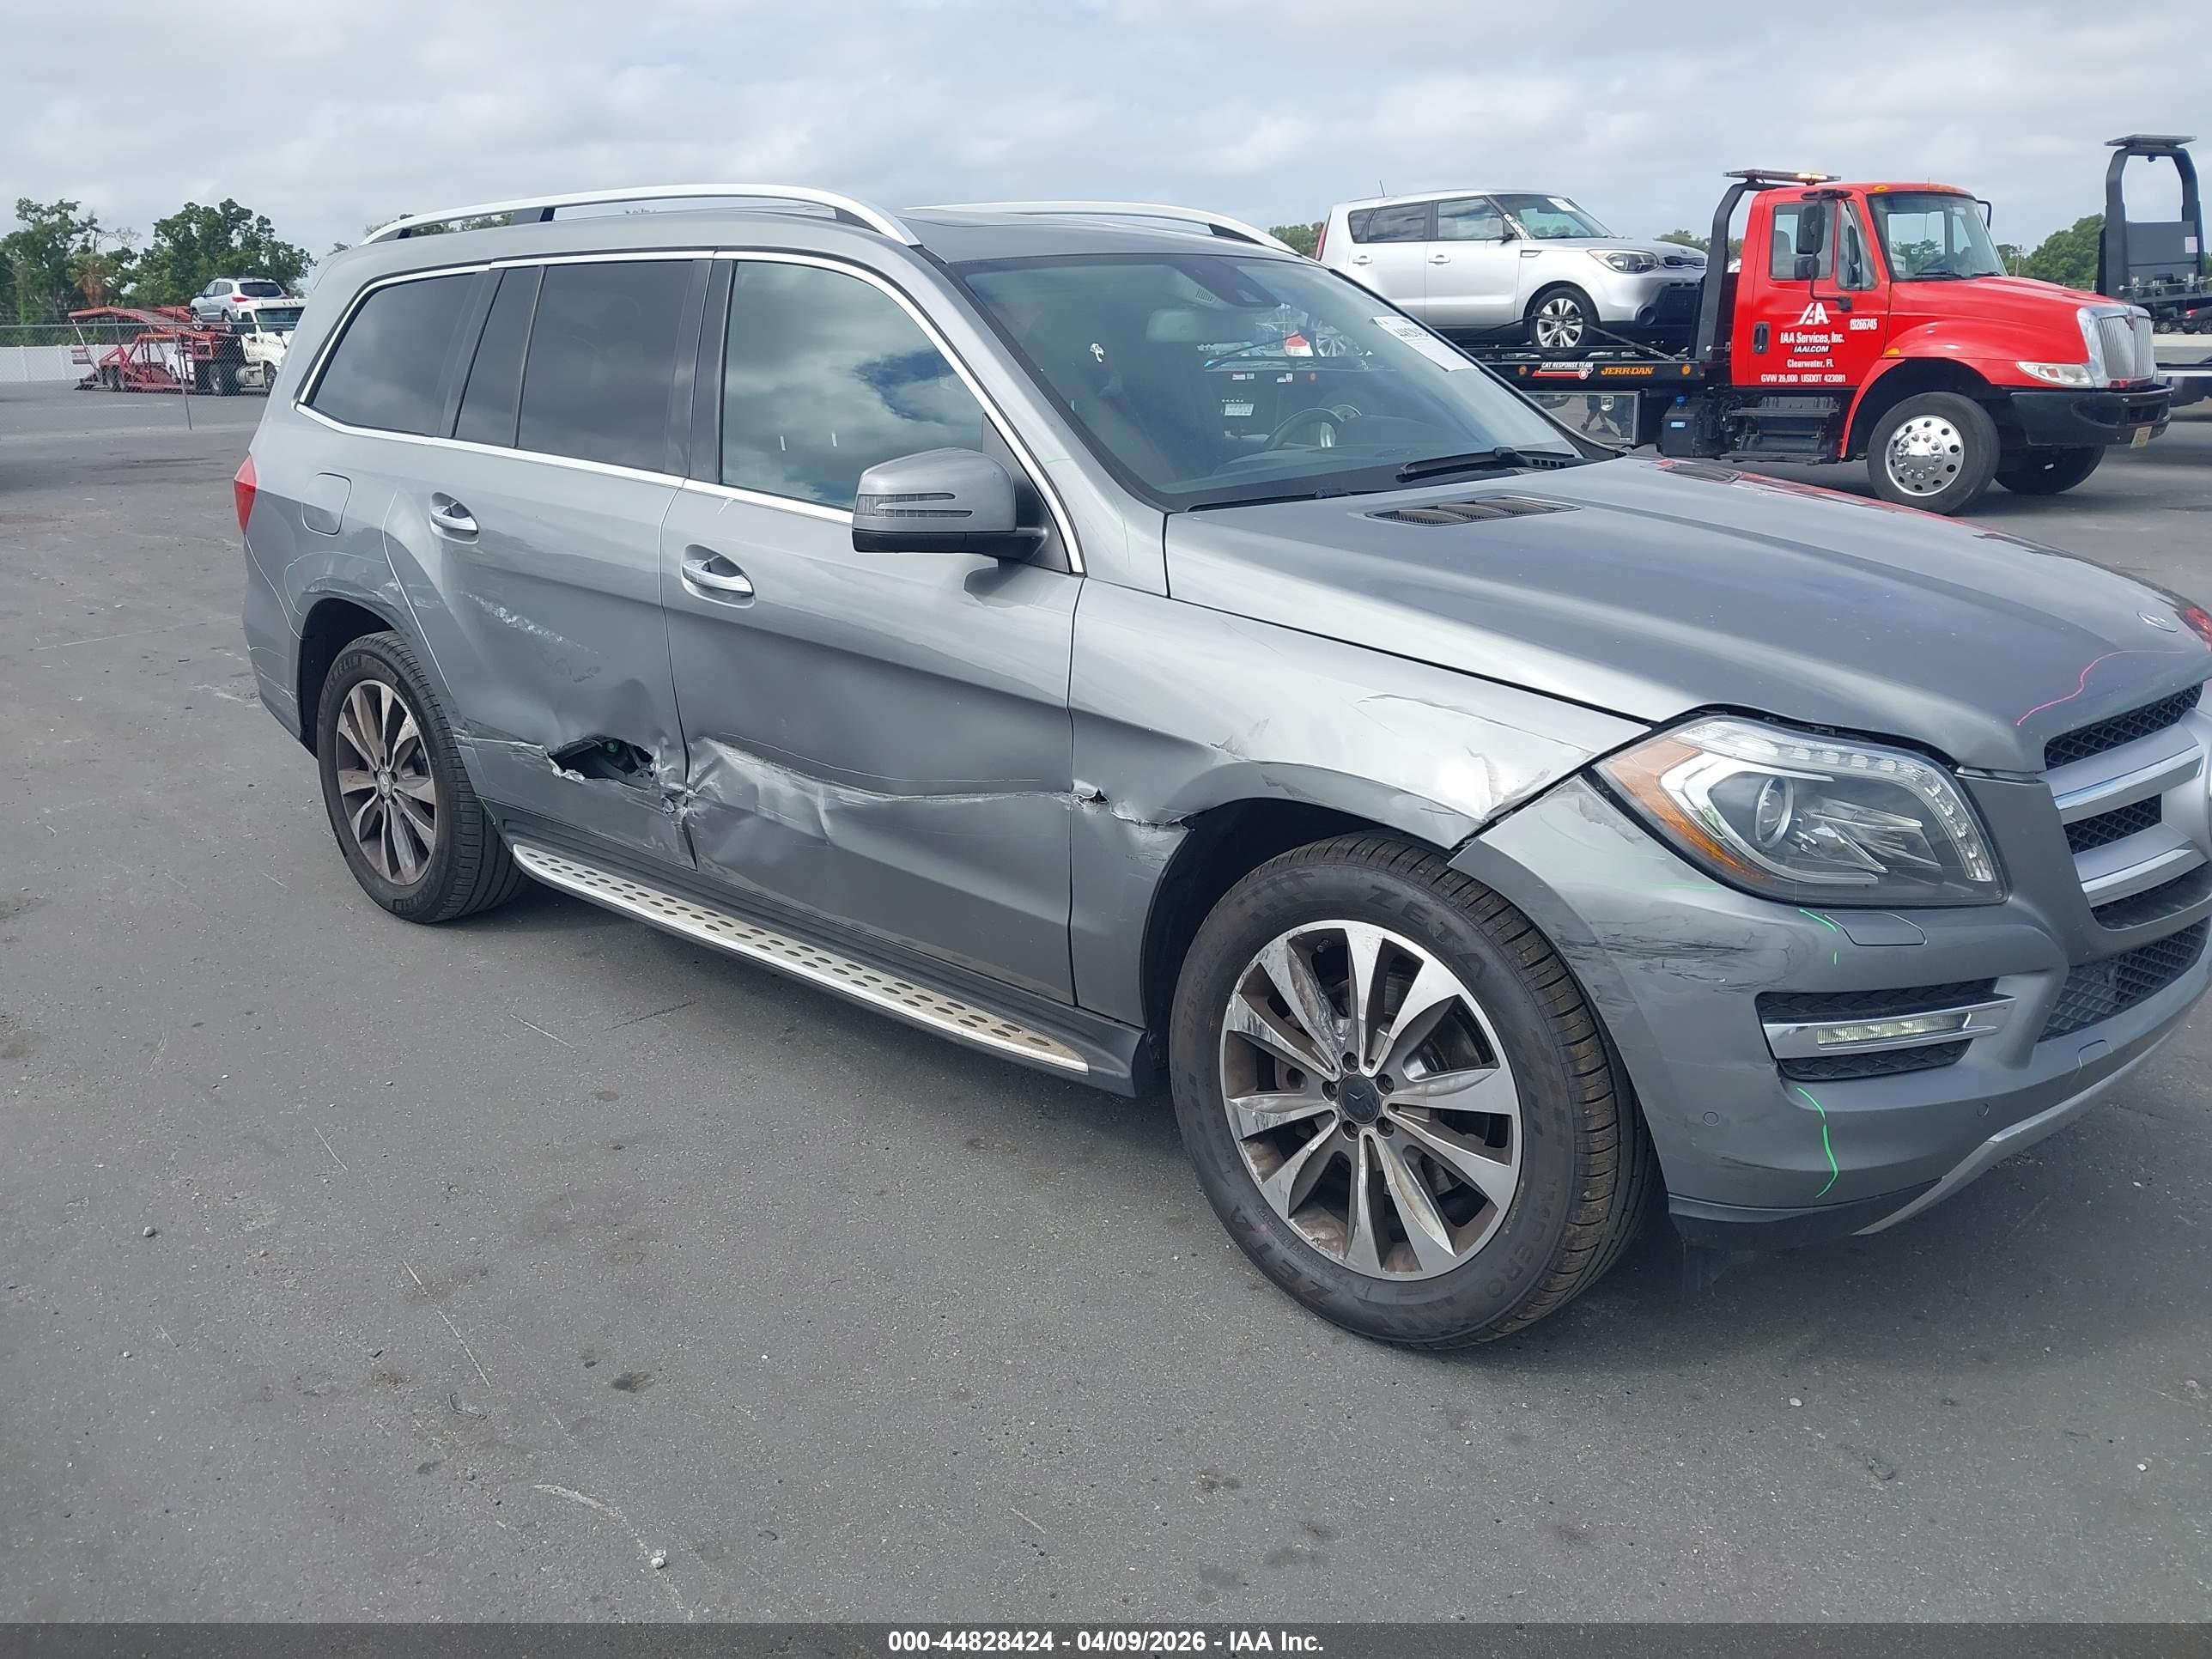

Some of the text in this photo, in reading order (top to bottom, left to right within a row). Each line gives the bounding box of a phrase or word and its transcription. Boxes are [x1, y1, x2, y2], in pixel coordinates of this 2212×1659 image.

[1780, 331, 1844, 344] IAA Services, Inc.
[1826, 358, 1834, 368] FL
